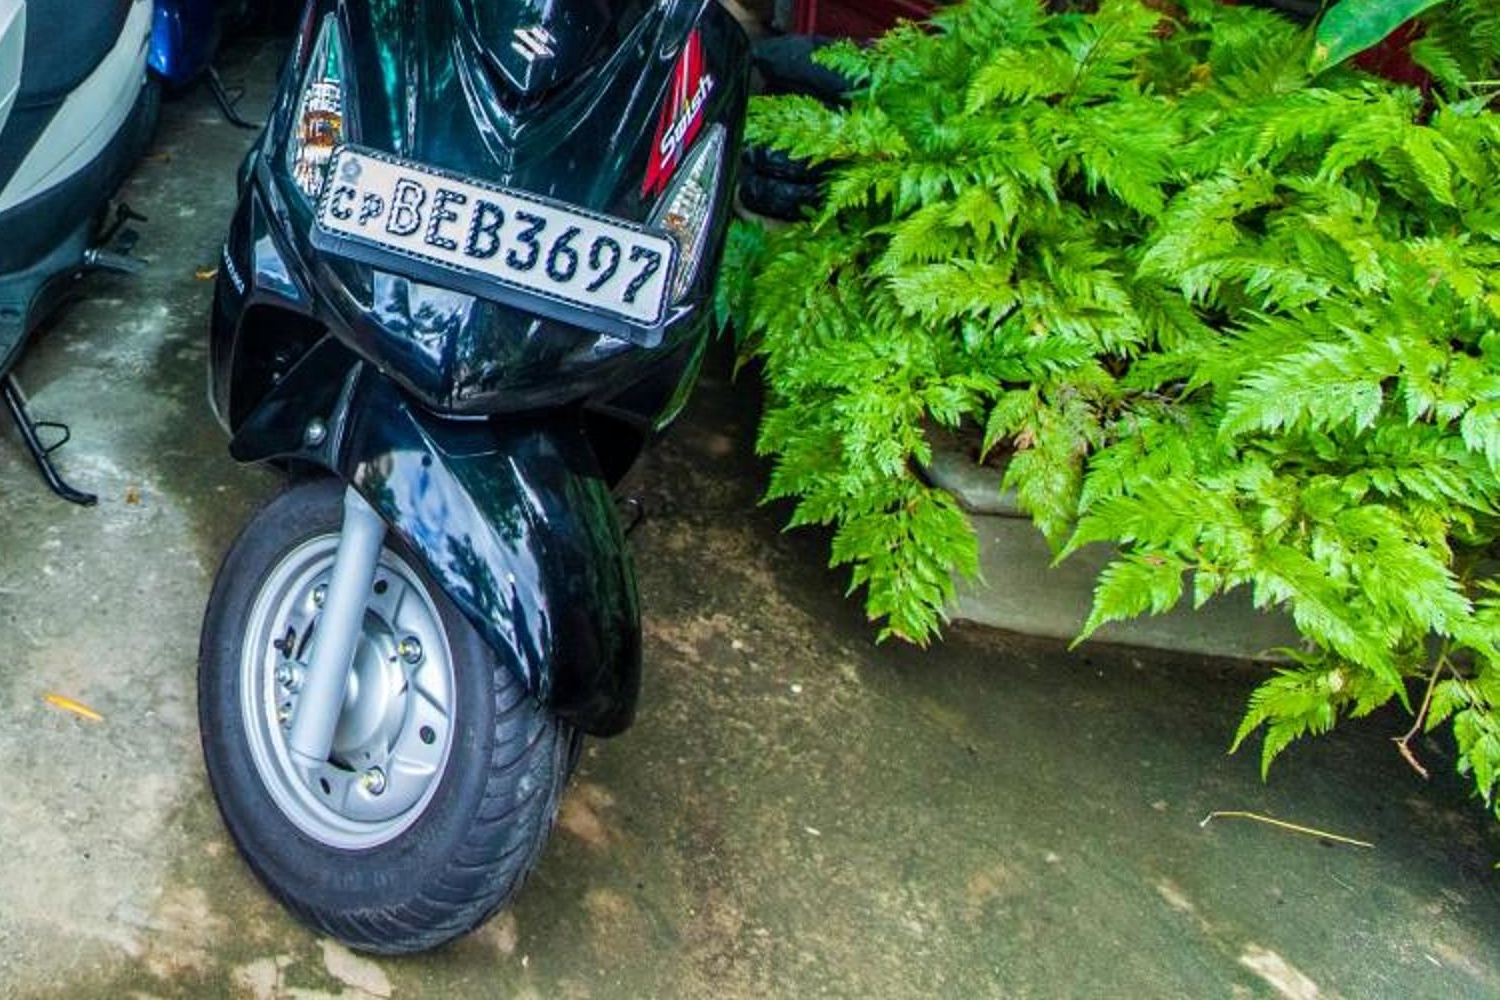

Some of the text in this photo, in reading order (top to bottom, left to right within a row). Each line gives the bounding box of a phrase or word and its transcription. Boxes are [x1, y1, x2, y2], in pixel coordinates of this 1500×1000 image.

[660, 73, 714, 169] Swish
[330, 179, 662, 304] CP BEB3697
